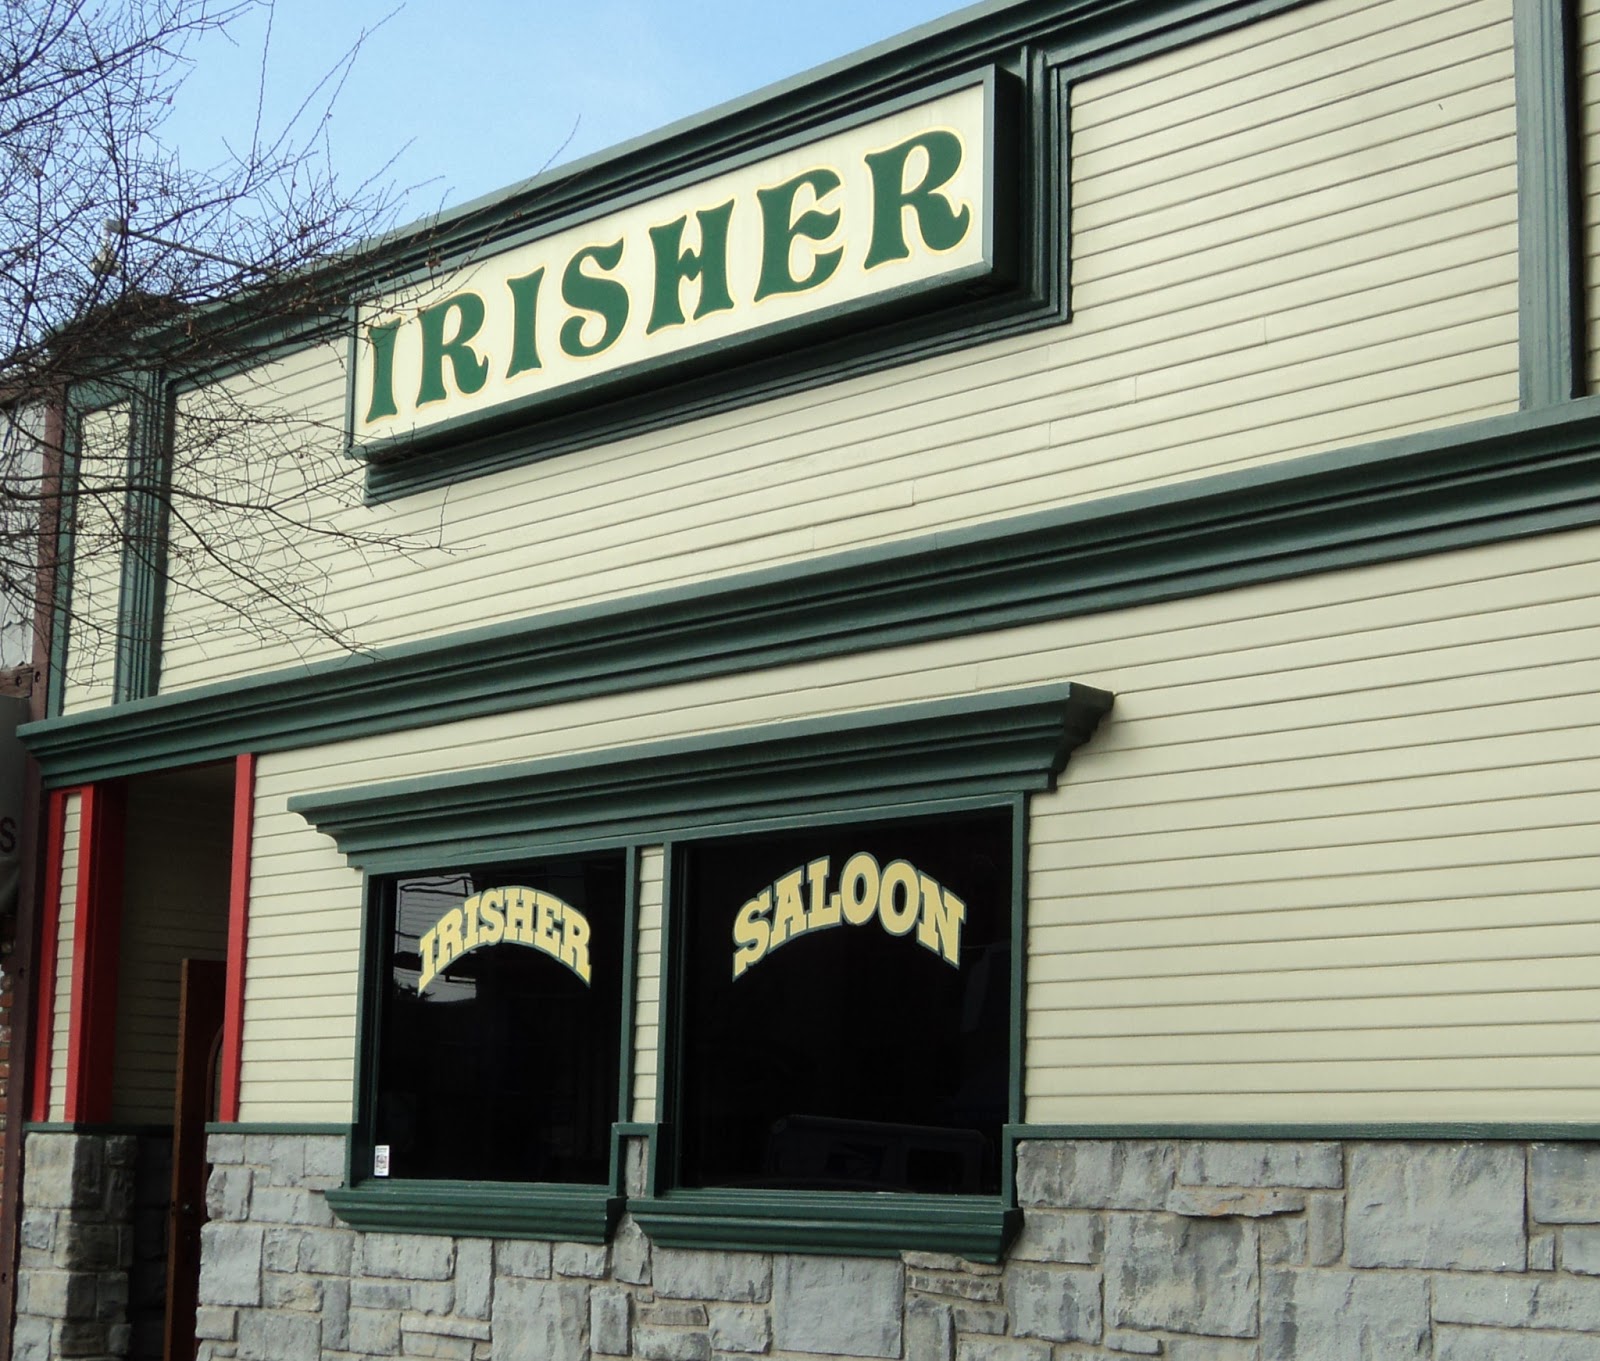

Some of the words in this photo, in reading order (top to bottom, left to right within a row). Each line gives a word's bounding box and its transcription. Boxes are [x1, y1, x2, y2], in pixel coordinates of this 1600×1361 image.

[365, 126, 971, 424] IRISHER
[418, 885, 592, 998] IRISHER
[732, 851, 967, 983] SALOON
